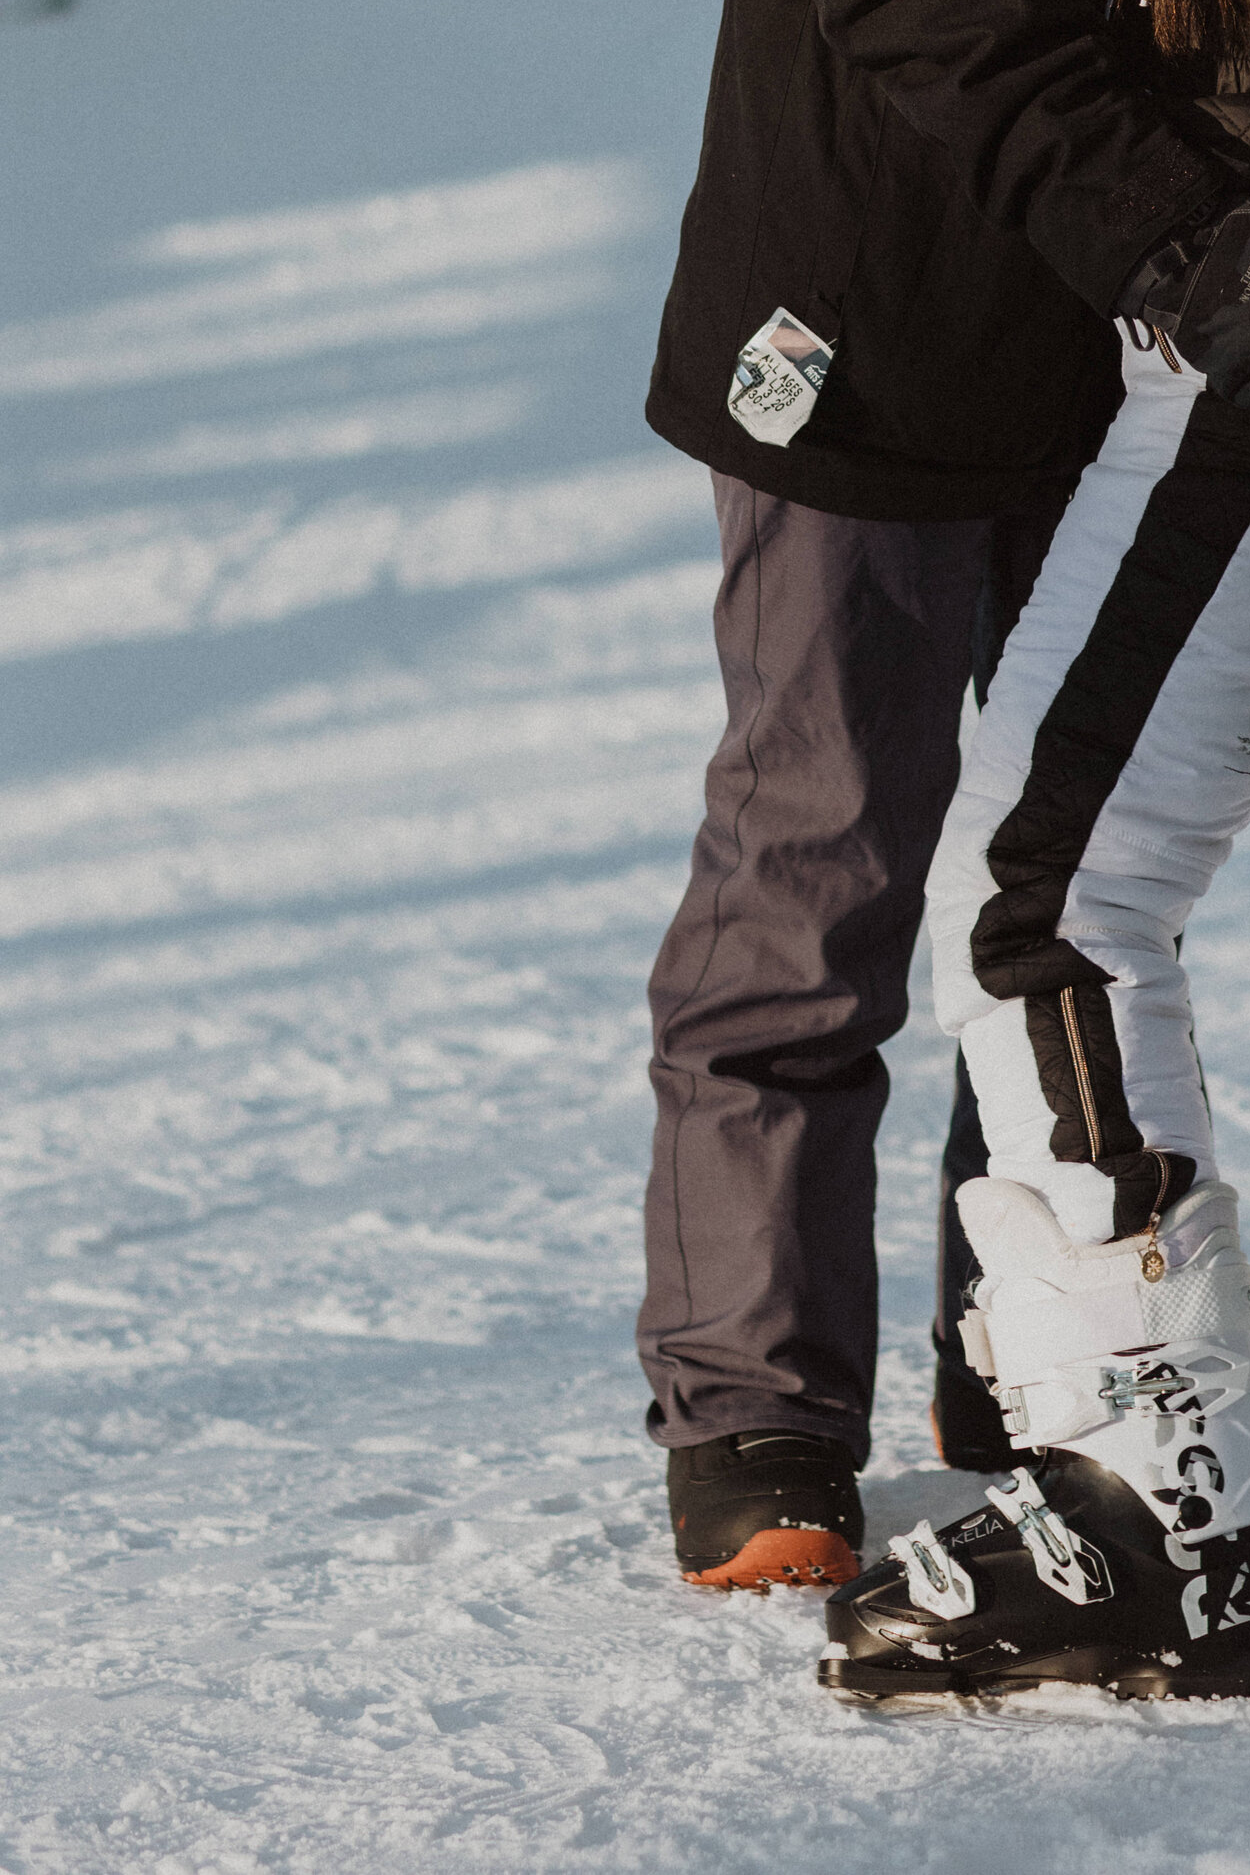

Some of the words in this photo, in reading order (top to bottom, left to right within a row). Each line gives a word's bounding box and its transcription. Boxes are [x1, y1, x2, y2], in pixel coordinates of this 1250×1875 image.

[761, 354, 780, 375] ALL
[779, 373, 803, 397] AGES
[762, 388, 773, 398] 3
[771, 398, 785, 412] 20
[769, 378, 796, 406] LIFTS
[951, 1519, 1004, 1547] KELIA
